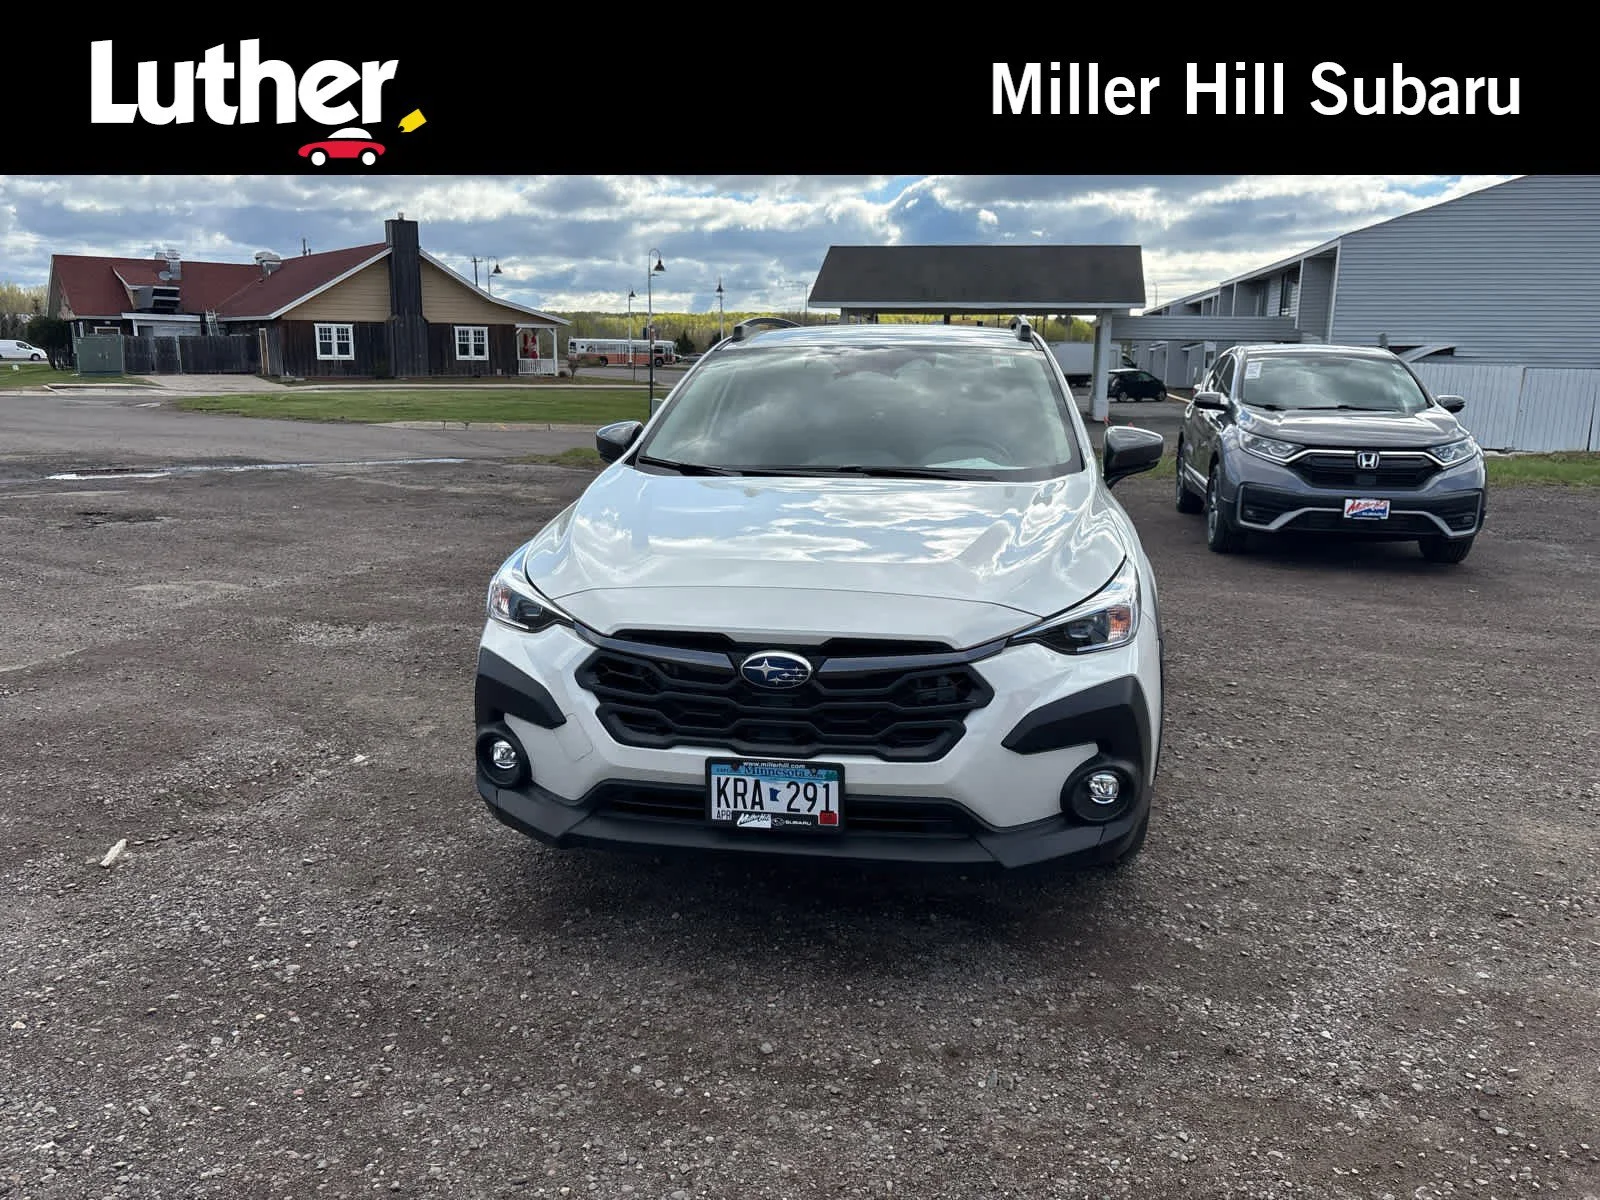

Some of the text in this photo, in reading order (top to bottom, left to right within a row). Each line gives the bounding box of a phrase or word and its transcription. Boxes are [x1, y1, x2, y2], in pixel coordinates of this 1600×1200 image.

[743, 761, 806, 769] www.millerhill.com
[745, 767, 805, 777] Minnesota
[716, 776, 831, 813] KRA 291
